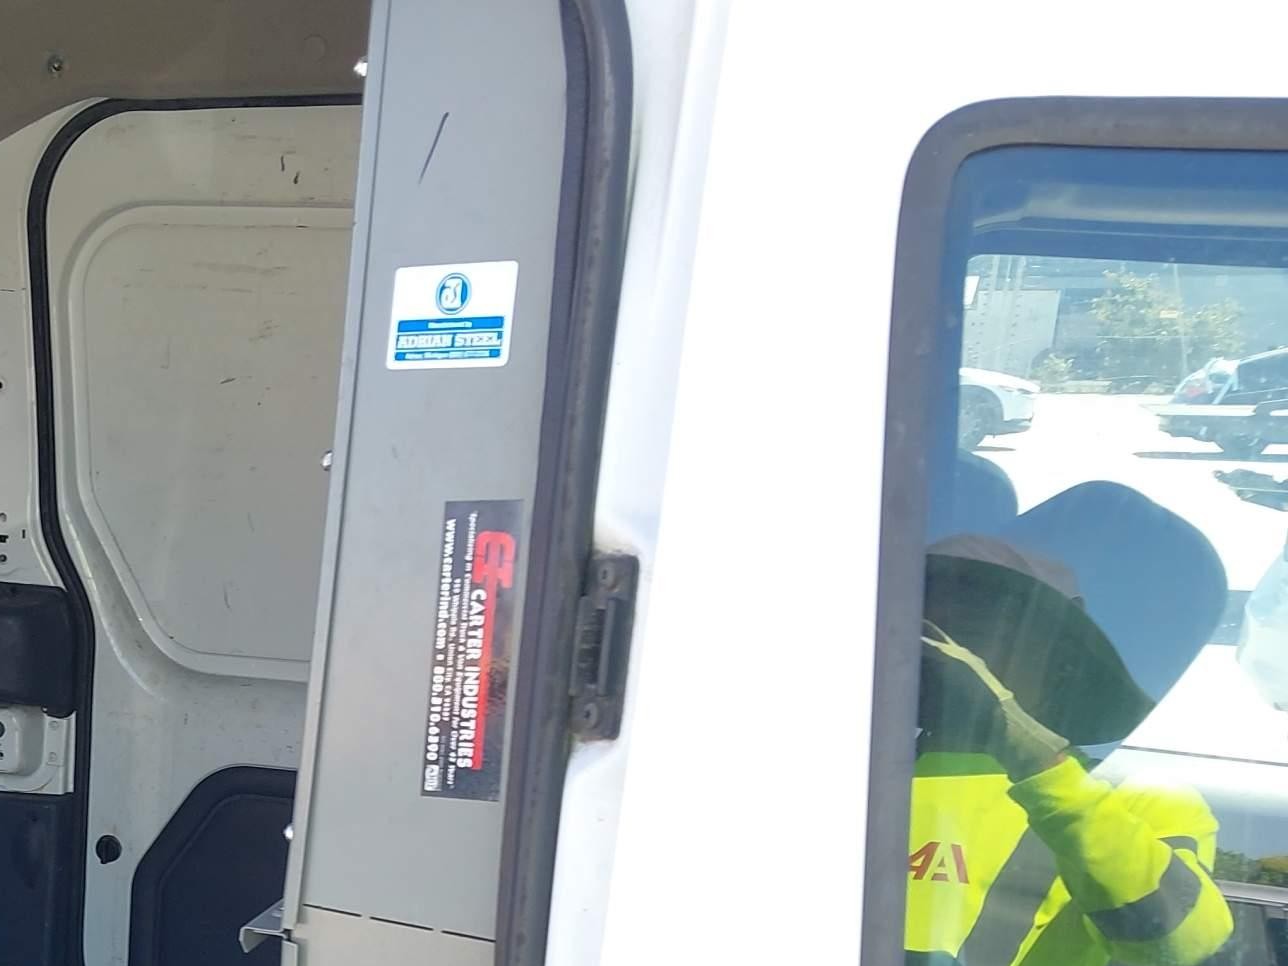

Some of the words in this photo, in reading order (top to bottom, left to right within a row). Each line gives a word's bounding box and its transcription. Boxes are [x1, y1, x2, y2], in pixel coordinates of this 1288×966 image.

[435, 519, 455, 649] www.carterind.com
[464, 589, 486, 660] CARTER
[456, 666, 480, 768] INDUSTRIES
